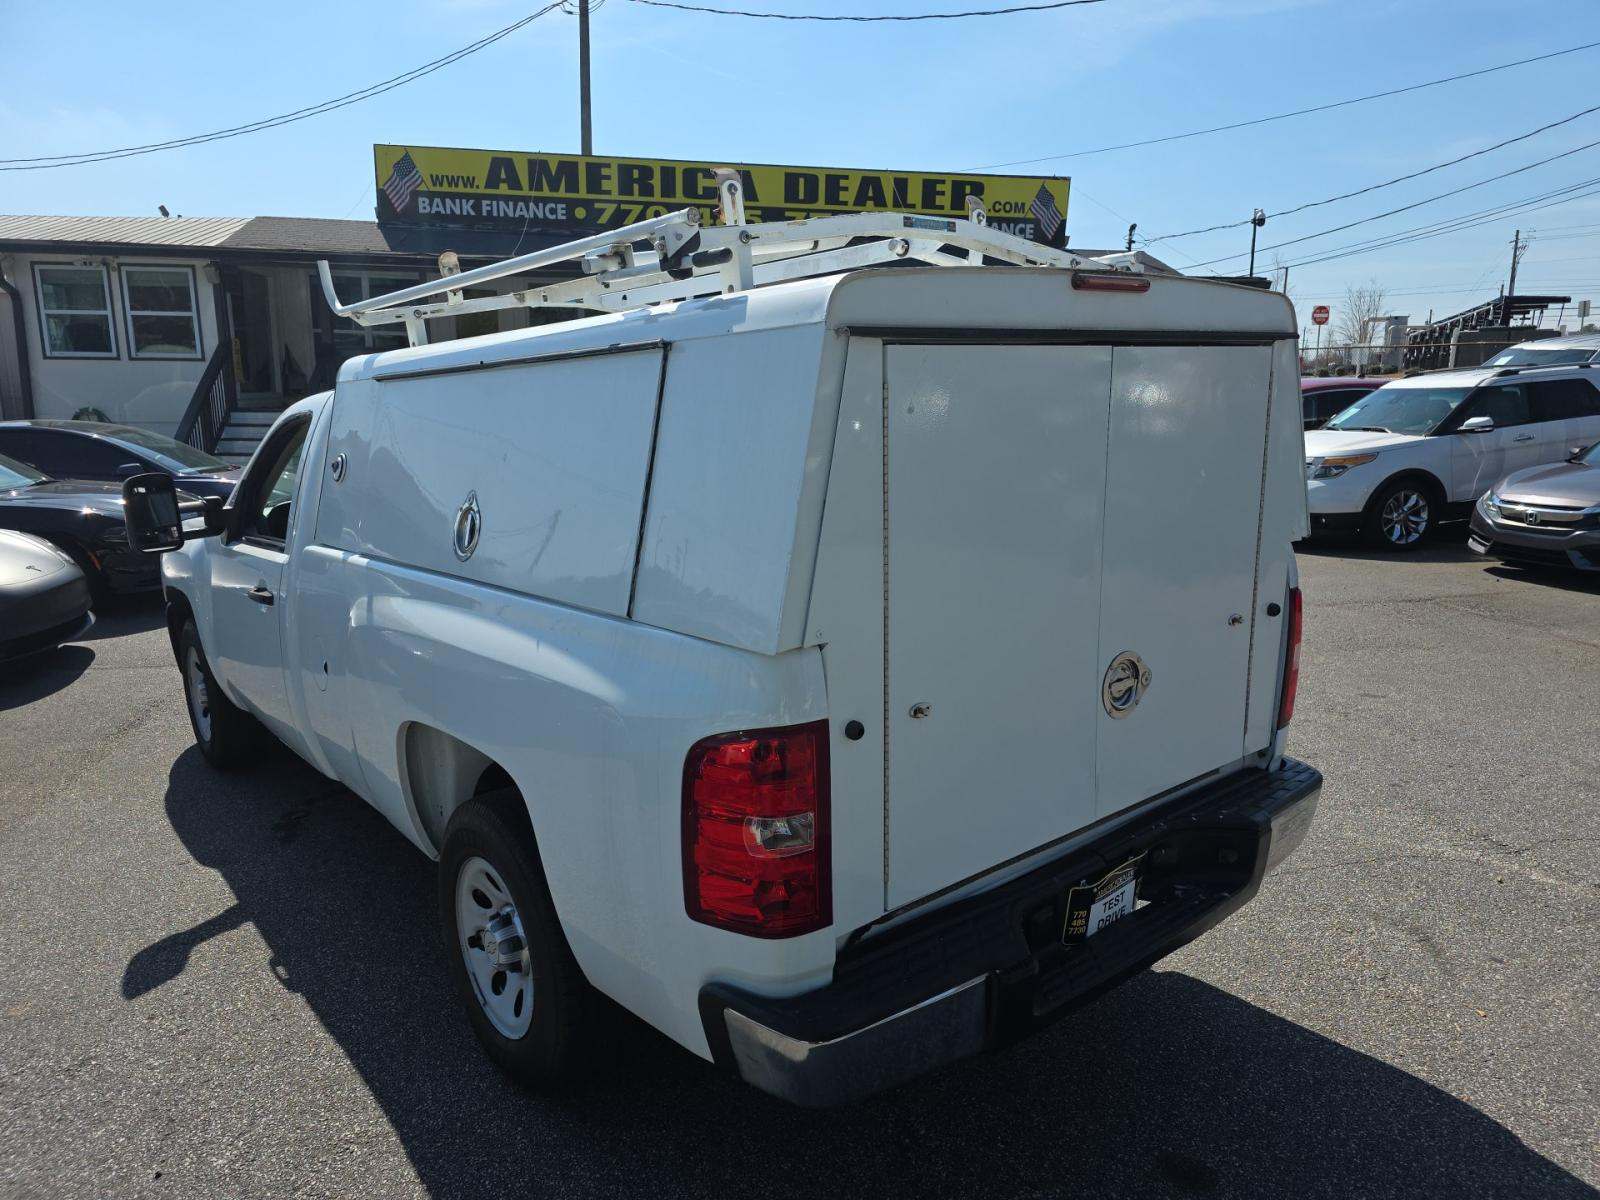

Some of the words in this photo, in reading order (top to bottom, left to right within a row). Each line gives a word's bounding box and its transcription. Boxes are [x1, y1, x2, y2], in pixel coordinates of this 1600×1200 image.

[783, 171, 985, 212] DEALER
[418, 197, 475, 215] BANK
[481, 200, 567, 220] FINANCE
[1103, 890, 1126, 914] TEST
